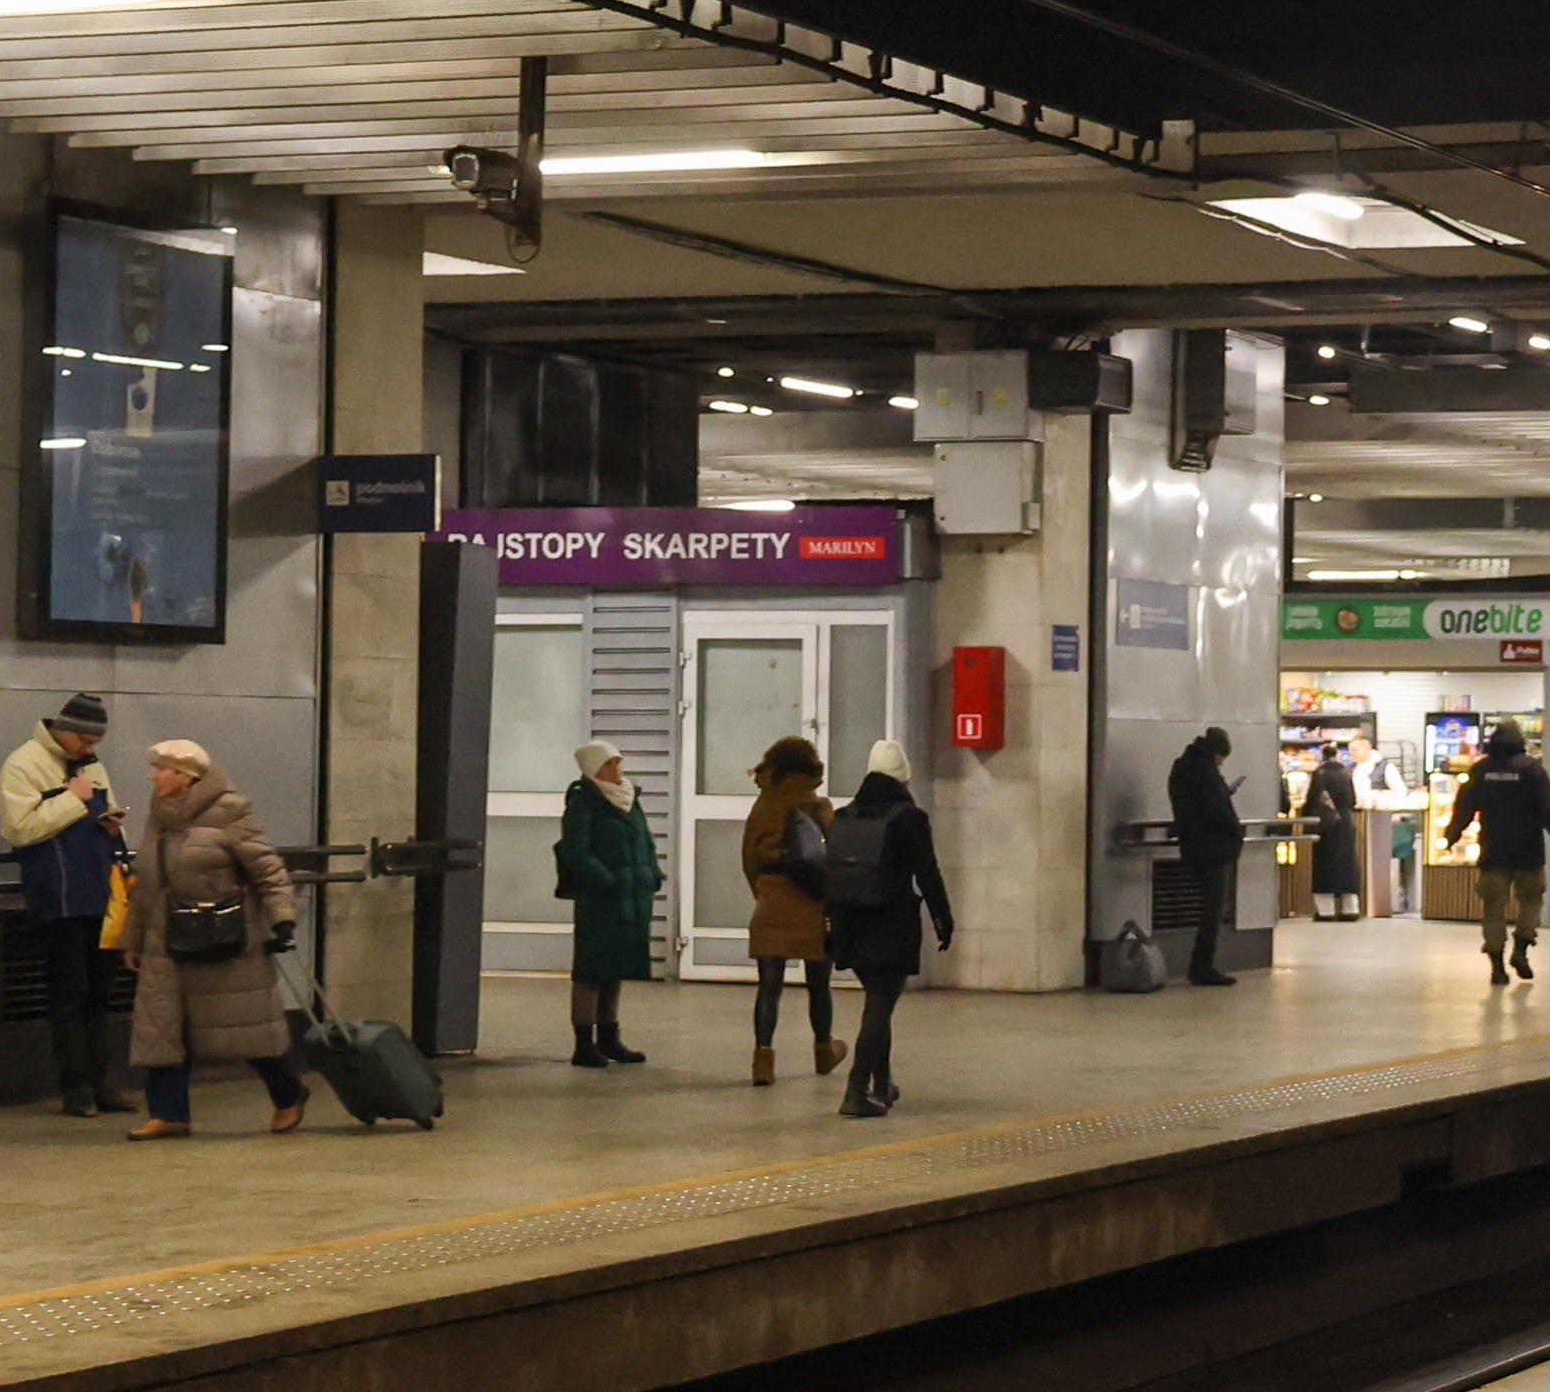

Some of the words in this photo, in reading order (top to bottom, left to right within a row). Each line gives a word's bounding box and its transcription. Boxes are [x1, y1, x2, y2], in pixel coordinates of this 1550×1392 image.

[623, 532, 791, 560] SKARPETY
[808, 541, 876, 555] MARILYN
[1440, 604, 1543, 634] onebite
